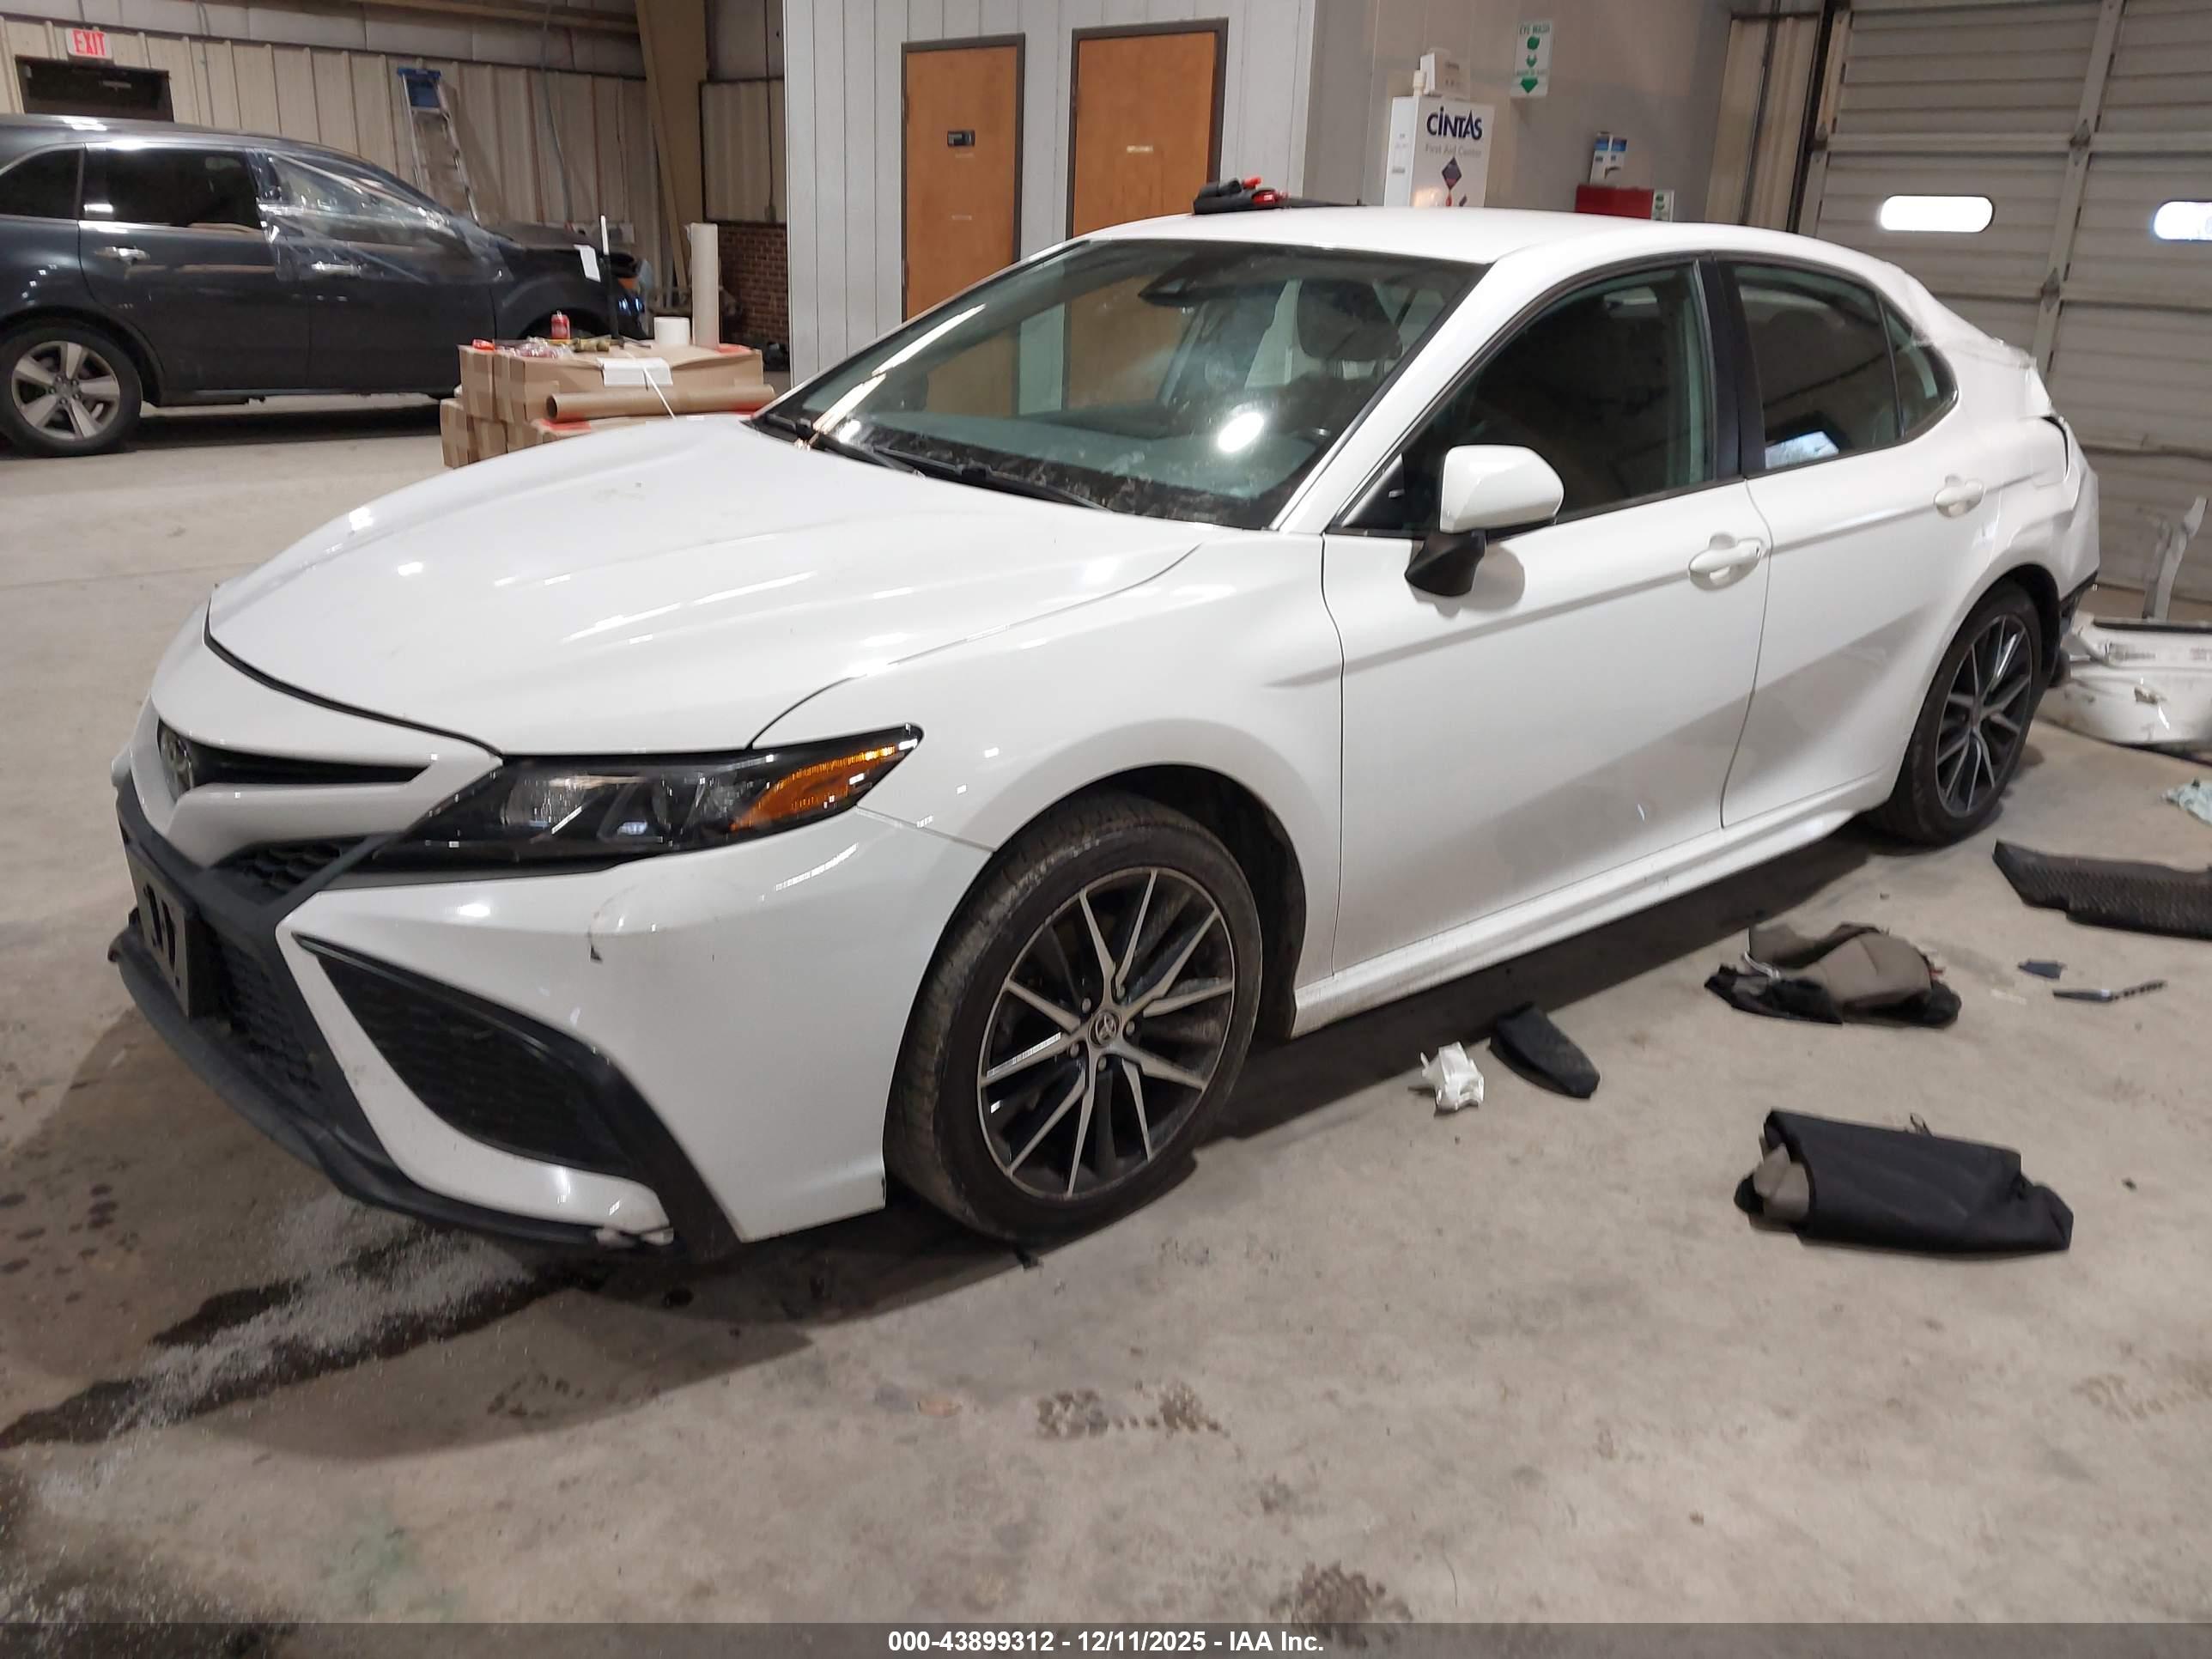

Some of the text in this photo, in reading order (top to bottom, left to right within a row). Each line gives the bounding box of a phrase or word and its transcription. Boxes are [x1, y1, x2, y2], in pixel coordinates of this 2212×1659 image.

[72, 27, 106, 56] EXIT
[1426, 105, 1483, 141] CINTAS
[1425, 143, 1482, 158] First Aid Center
